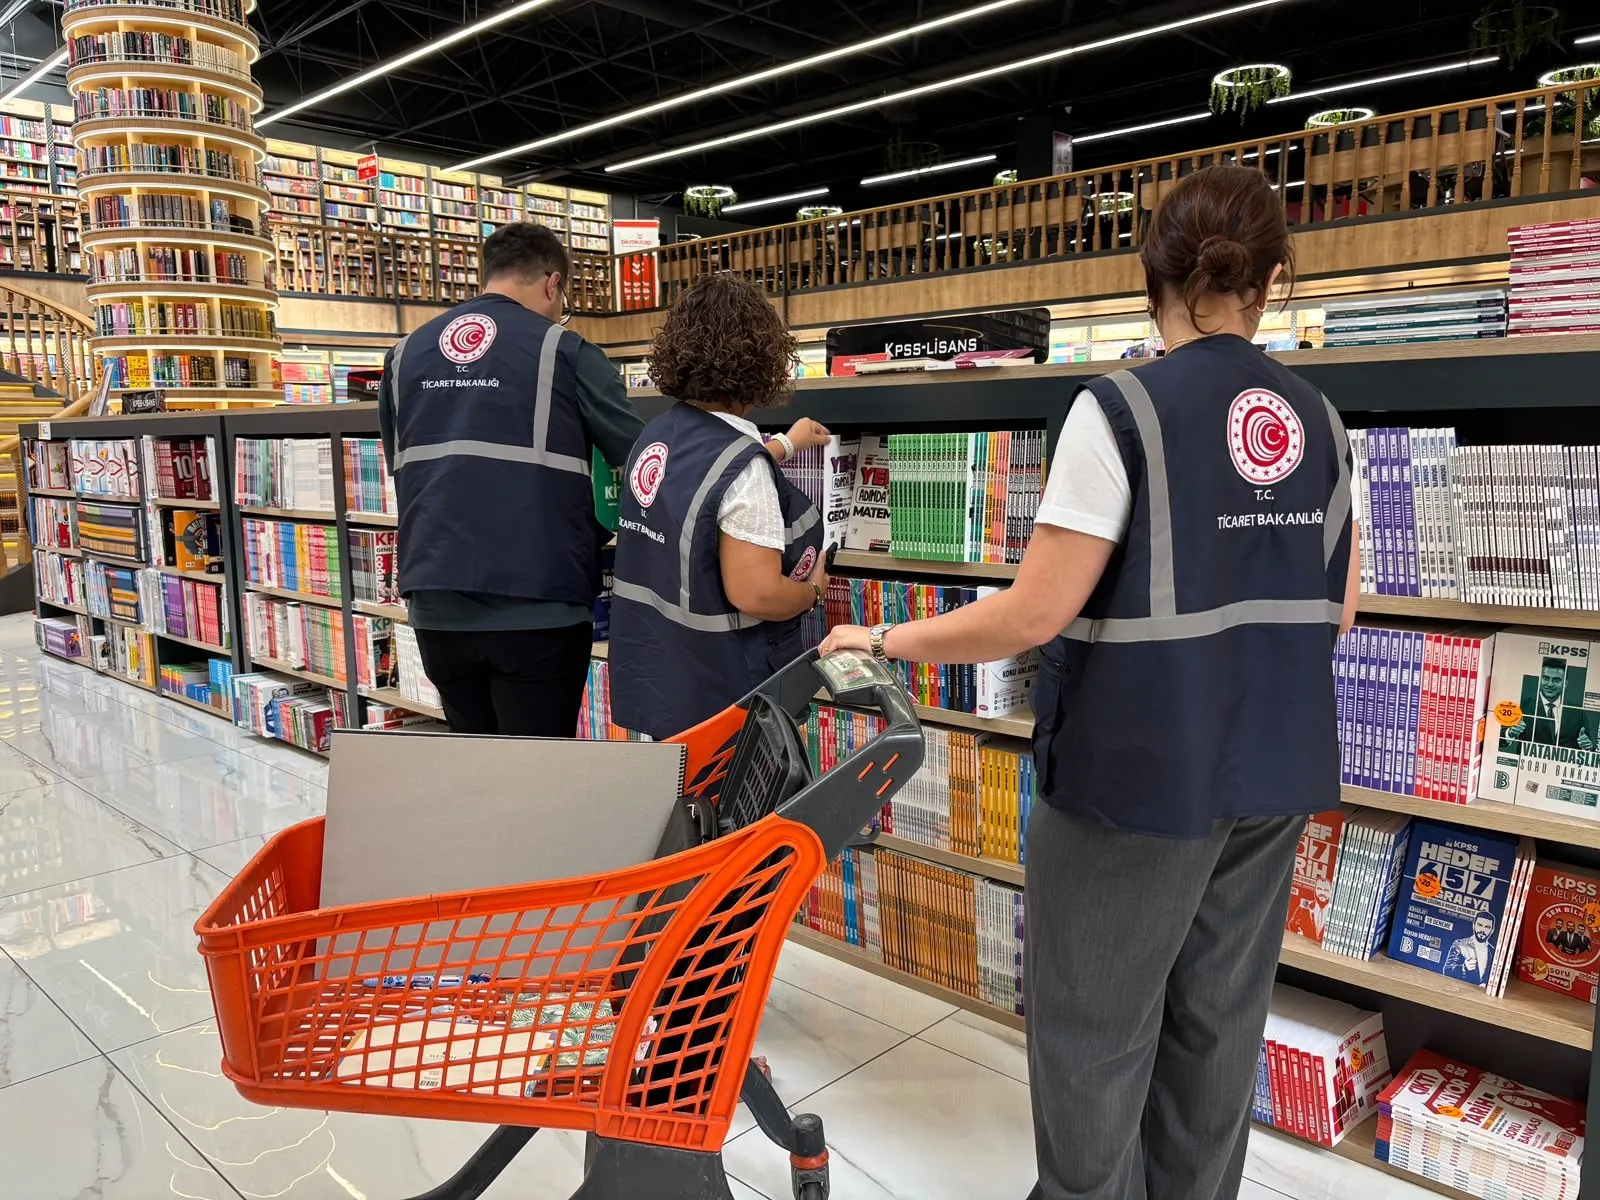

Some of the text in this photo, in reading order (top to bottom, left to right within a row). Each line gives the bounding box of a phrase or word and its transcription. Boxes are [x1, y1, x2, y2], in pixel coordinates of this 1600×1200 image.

[885, 337, 977, 358] KPSS-LİSANS
[455, 365, 469, 373] T.C.
[421, 377, 500, 390] TİCARET BAKANLIĞI
[858, 489, 887, 504] ADIMDA
[1254, 489, 1275, 501] T.C.
[1217, 508, 1324, 530] TİCARET BAKANLIĞI
[376, 532, 394, 546] KP
[372, 618, 390, 632] KP
[1550, 644, 1588, 657] KPSS
[1003, 668, 1017, 678] KONU
[1520, 759, 1547, 774] SORU
[1555, 765, 1600, 783] BANKAS
[1453, 840, 1479, 853] KPSS
[1419, 841, 1500, 875] HEDEF
[1535, 884, 1569, 900] GENEL
[1552, 875, 1597, 896] KPSS
[1545, 907, 1561, 919] SEN
[1549, 967, 1571, 978] soru
[1547, 976, 1569, 987] cevap
[1408, 1072, 1438, 1096] ÇIKTI
[1460, 1097, 1496, 1126] TARİH
[1503, 1122, 1523, 1140] SORU
[1517, 1116, 1543, 1145] BANKASI
